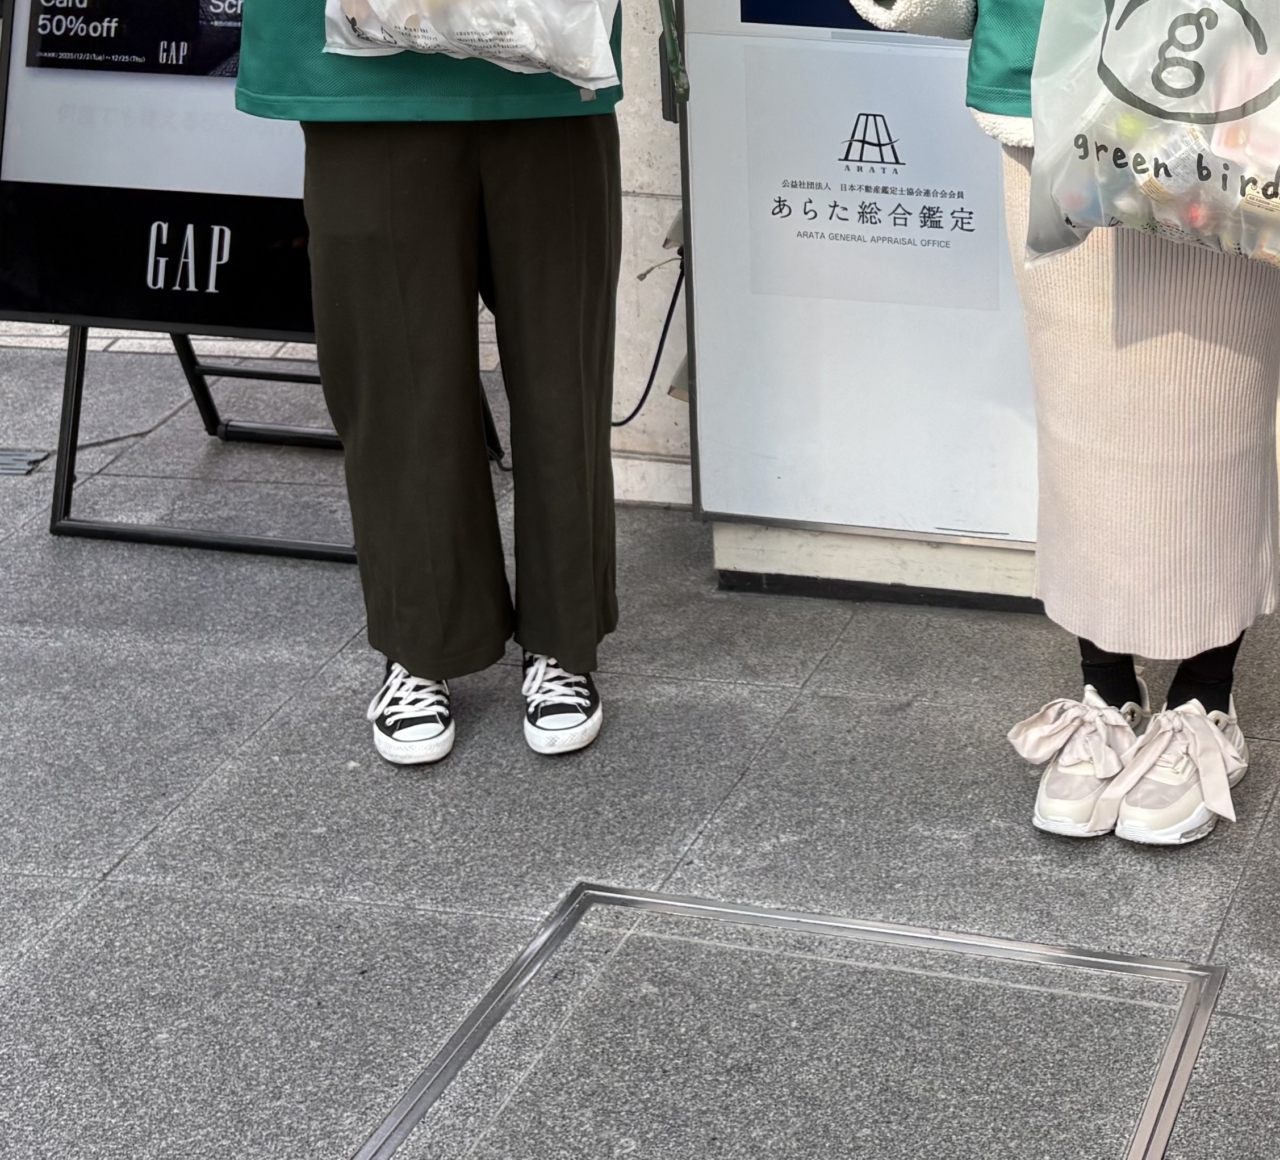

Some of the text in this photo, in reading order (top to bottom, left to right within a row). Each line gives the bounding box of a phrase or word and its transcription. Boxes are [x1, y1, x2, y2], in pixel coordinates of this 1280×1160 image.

[158, 40, 188, 65] GAP
[1073, 133, 1173, 179] green
[844, 165, 899, 175] ARATA
[781, 179, 832, 191] 公益社団法人
[771, 196, 976, 233] あらた総合鑑定
[796, 230, 951, 249] ARATA GENERAL APPRAISAL OFFICE
[147, 221, 231, 293] GAP
